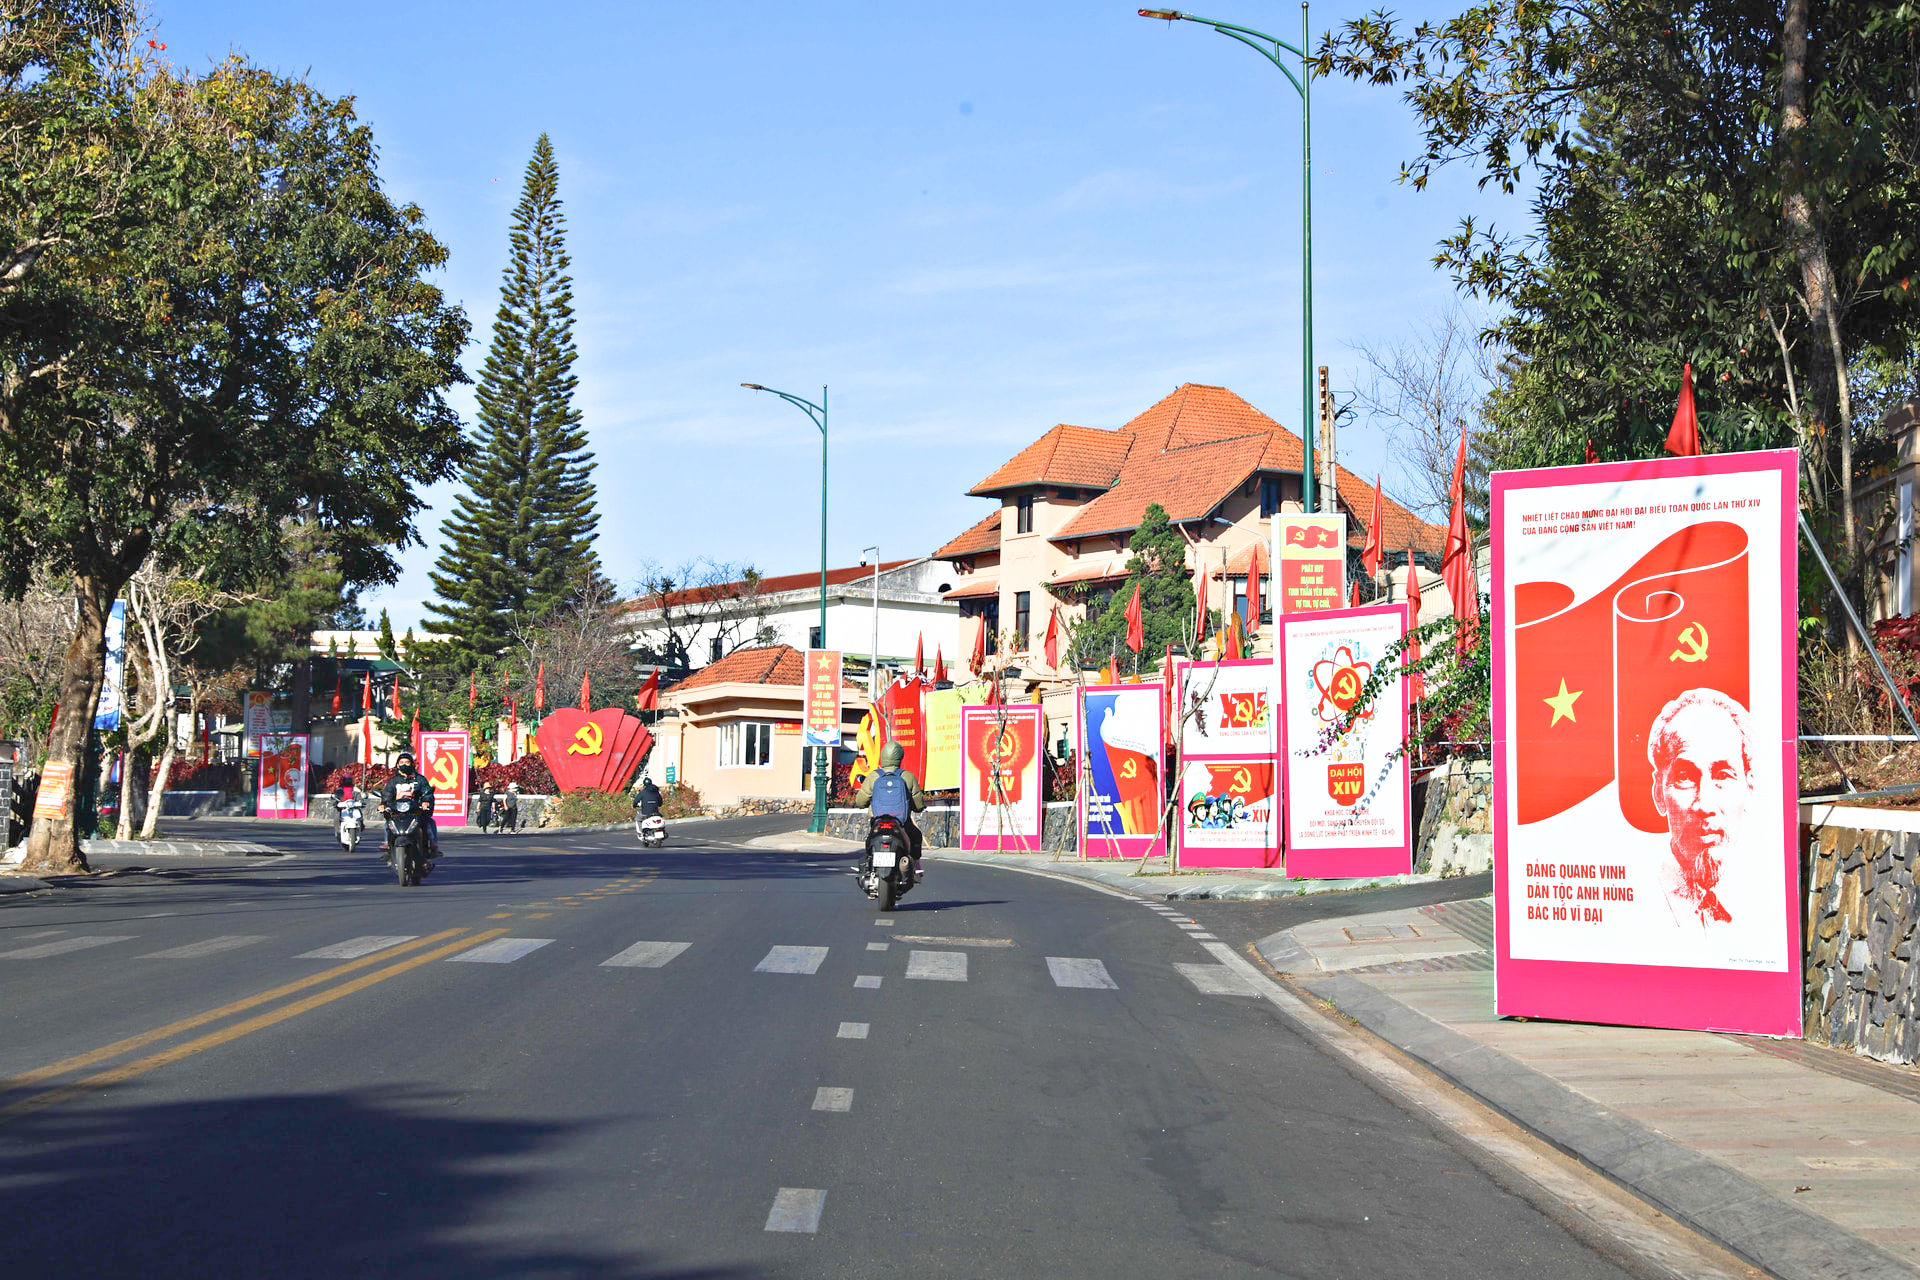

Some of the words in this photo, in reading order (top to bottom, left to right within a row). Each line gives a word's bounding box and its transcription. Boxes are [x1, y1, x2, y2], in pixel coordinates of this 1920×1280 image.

[1748, 498, 1761, 508] XIV
[1615, 520, 1637, 530] NAM!
[1333, 780, 1361, 795] XIV
[1252, 808, 1271, 824] XIV
[1526, 859, 1556, 878] ĐẢNG
[1559, 863, 1596, 880] QUANG
[1599, 864, 1626, 880] VINH
[1527, 881, 1550, 899] DÂN
[1552, 882, 1573, 902] TỘC
[1576, 885, 1600, 901] ANH
[1603, 883, 1634, 902] HÙNG
[1527, 903, 1549, 921] BÁC
[1552, 902, 1567, 921] HỒ
[1570, 904, 1581, 922] VĨ
[1584, 907, 1603, 926] ĐẠI
